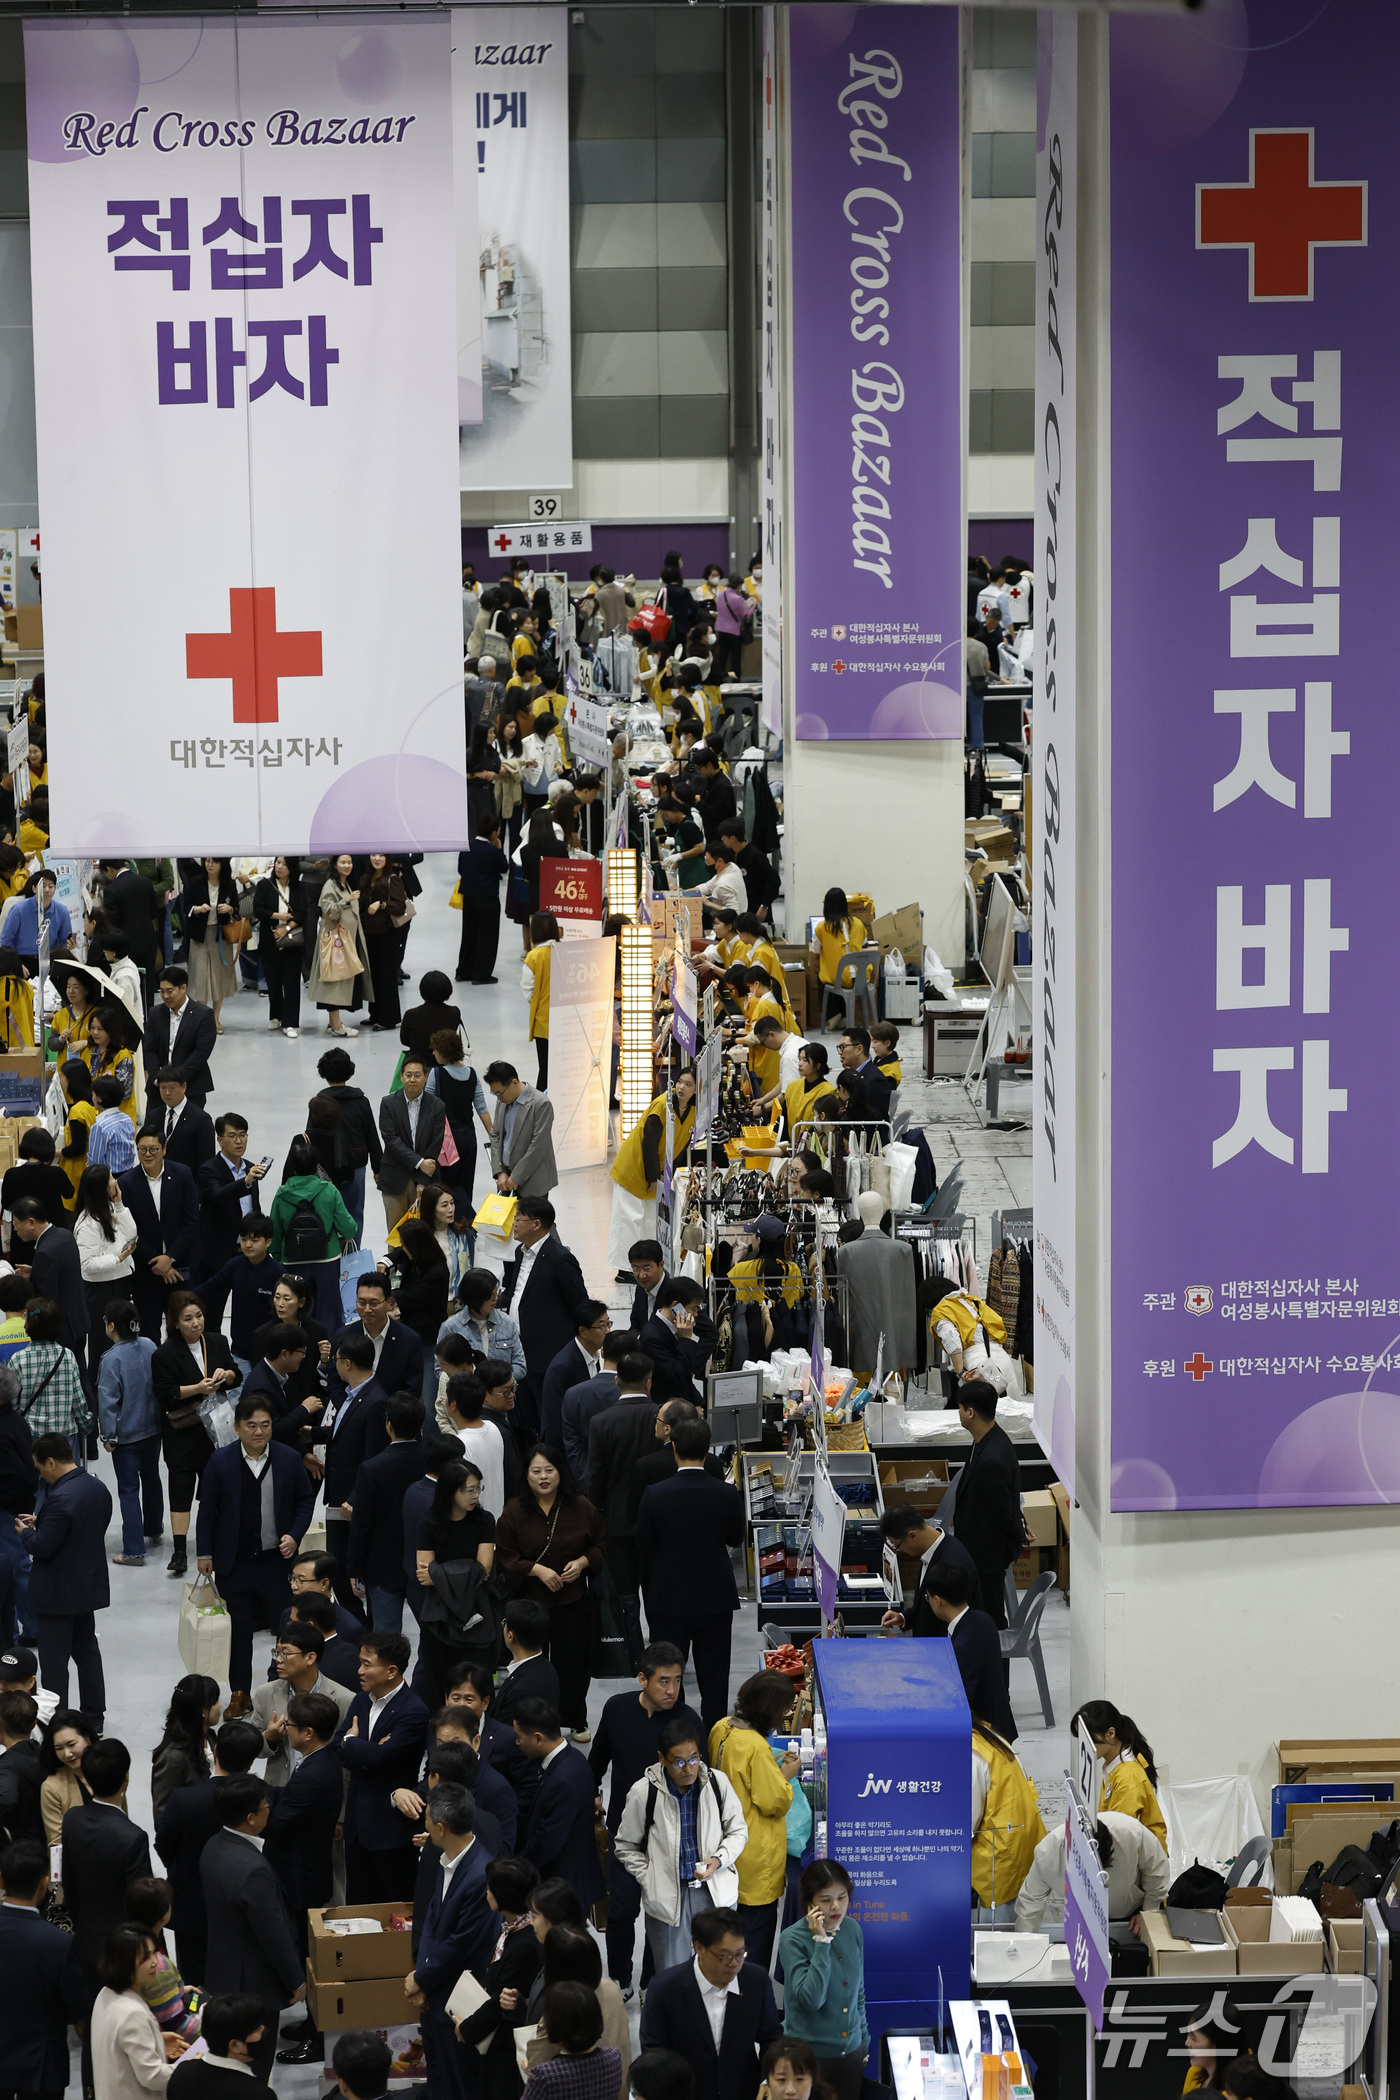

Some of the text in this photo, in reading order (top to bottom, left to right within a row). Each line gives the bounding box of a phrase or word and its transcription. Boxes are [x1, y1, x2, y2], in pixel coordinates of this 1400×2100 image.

[63, 106, 416, 156] Red Cross Bazaar
[107, 193, 384, 291] 적십자
[837, 49, 912, 588] Red Cross Bazaar
[157, 315, 340, 408] 바자
[534, 498, 557, 516] 39
[520, 531, 583, 548] 재활용품
[810, 628, 942, 645] 주관 여성봉사특별자문위원회
[849, 623, 919, 633] 대한적십자사 본사
[810, 661, 945, 672] 후원 대한적십자사 수요봉사회
[1043, 132, 1064, 1184] Red Cross Bazaar
[579, 665, 590, 689] 36
[170, 736, 343, 768] 대한적십자사
[1213, 351, 1350, 1173] 적십자 바자
[554, 880, 586, 900] 46 %
[563, 906, 574, 914] 이상
[574, 906, 594, 915] 무료배송
[1220, 1278, 1360, 1302] 대한적십자사 본사
[1142, 1293, 1176, 1311] 주관
[1142, 1359, 1176, 1378] 후원
[1219, 1356, 1321, 1377] 대한적십자사
[1080, 1741, 1093, 1803] 27
[896, 1780, 942, 1794] 생활건강
[834, 1821, 892, 1829] 아무리 좋은 악기라도
[834, 1830, 853, 1838] 조율을
[854, 1829, 867, 1837] 하지
[867, 1829, 886, 1837] 않으면
[887, 1829, 905, 1837] 고유의
[906, 1829, 924, 1837] 소리를
[938, 1828, 965, 1836] 못합니다.
[834, 1846, 853, 1854] 꾸준한
[854, 1846, 872, 1854] 조율이
[873, 1846, 892, 1854] 없다면
[892, 1845, 911, 1853] 세상에
[911, 1845, 936, 1853] 하나뿐인
[937, 1845, 949, 1853] 나의
[834, 1854, 848, 1862] 나의
[886, 1854, 894, 1862] 낼
[894, 1854, 901, 1862] 수
[901, 1854, 928, 1862] 없습니다.
[853, 1879, 898, 1887] 일상을 누리도록
[859, 1871, 884, 1879] 화음으로
[853, 1901, 862, 1909] in
[863, 1900, 886, 1909] Tune
[863, 1912, 889, 1922] 온전한
